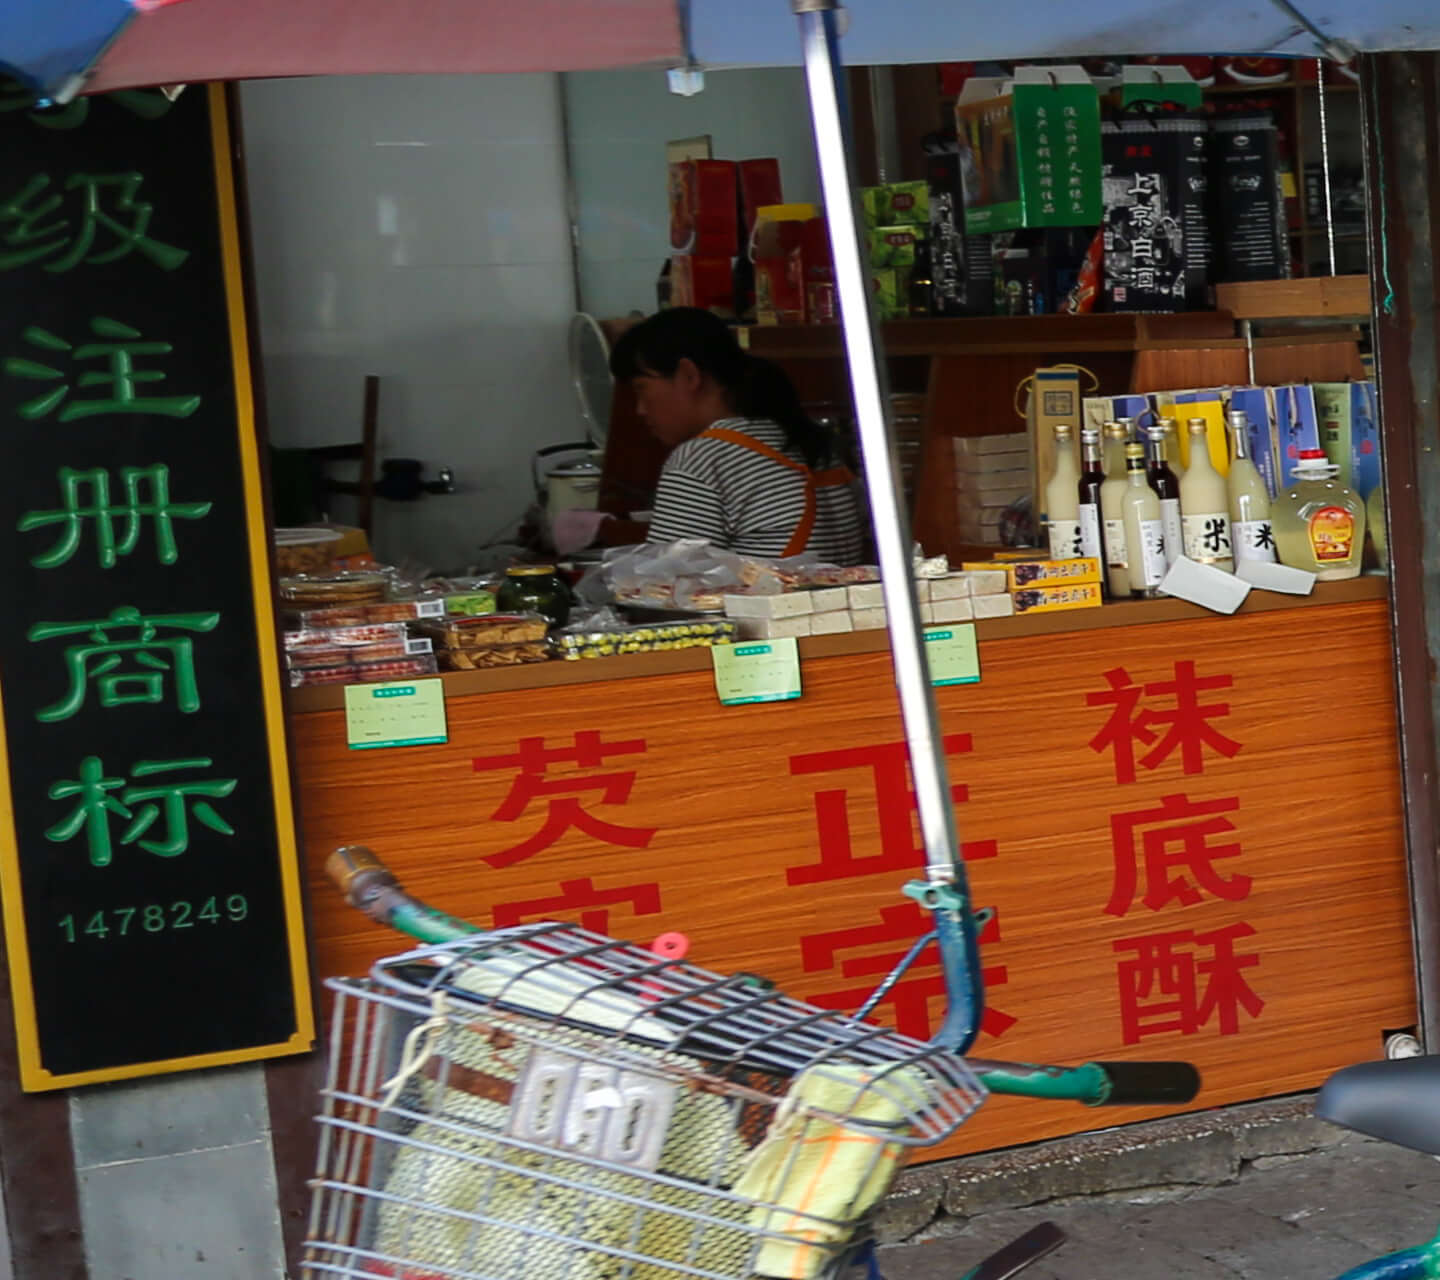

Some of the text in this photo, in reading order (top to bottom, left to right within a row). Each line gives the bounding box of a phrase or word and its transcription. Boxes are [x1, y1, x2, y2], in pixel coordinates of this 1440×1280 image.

[1127, 171, 1155, 288] 上京白酒
[0, 85, 237, 867] 级注册商标
[57, 891, 250, 944] 1478249
[786, 732, 1018, 1050] 正宗
[1085, 660, 1266, 1047] 袜底酥
